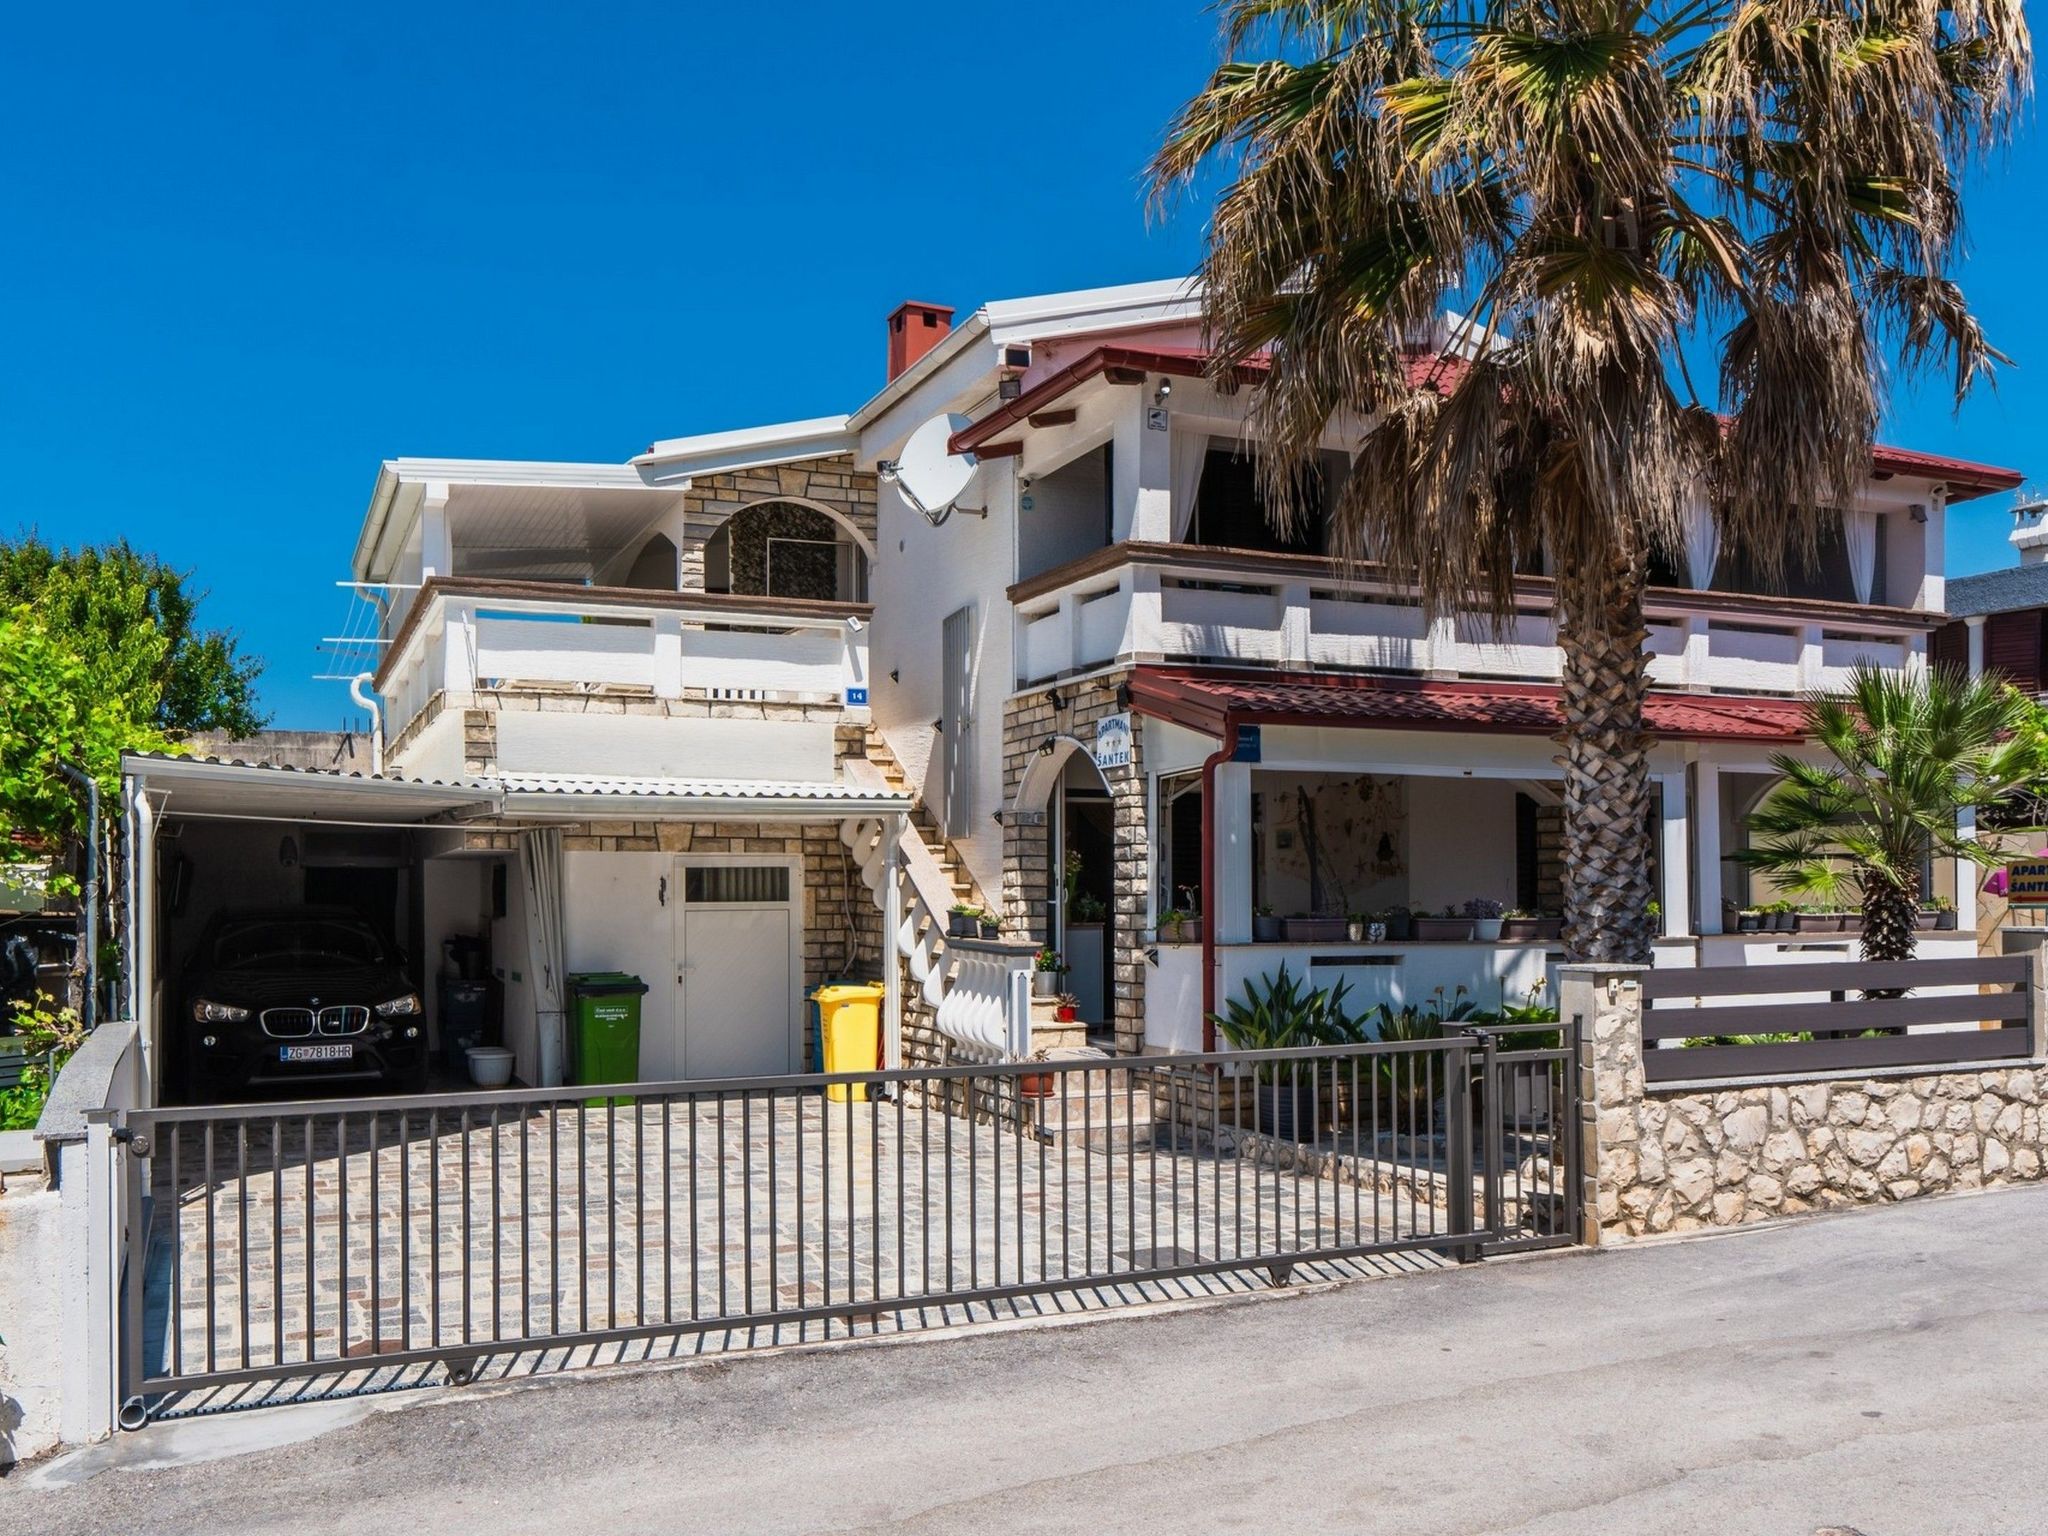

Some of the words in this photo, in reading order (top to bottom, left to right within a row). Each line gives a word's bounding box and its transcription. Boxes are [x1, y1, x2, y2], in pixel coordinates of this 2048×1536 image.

[852, 692, 863, 700] 14
[1097, 752, 1129, 767] ŠANTEK
[2011, 864, 2048, 876] APAR
[289, 1048, 302, 1059] ZG
